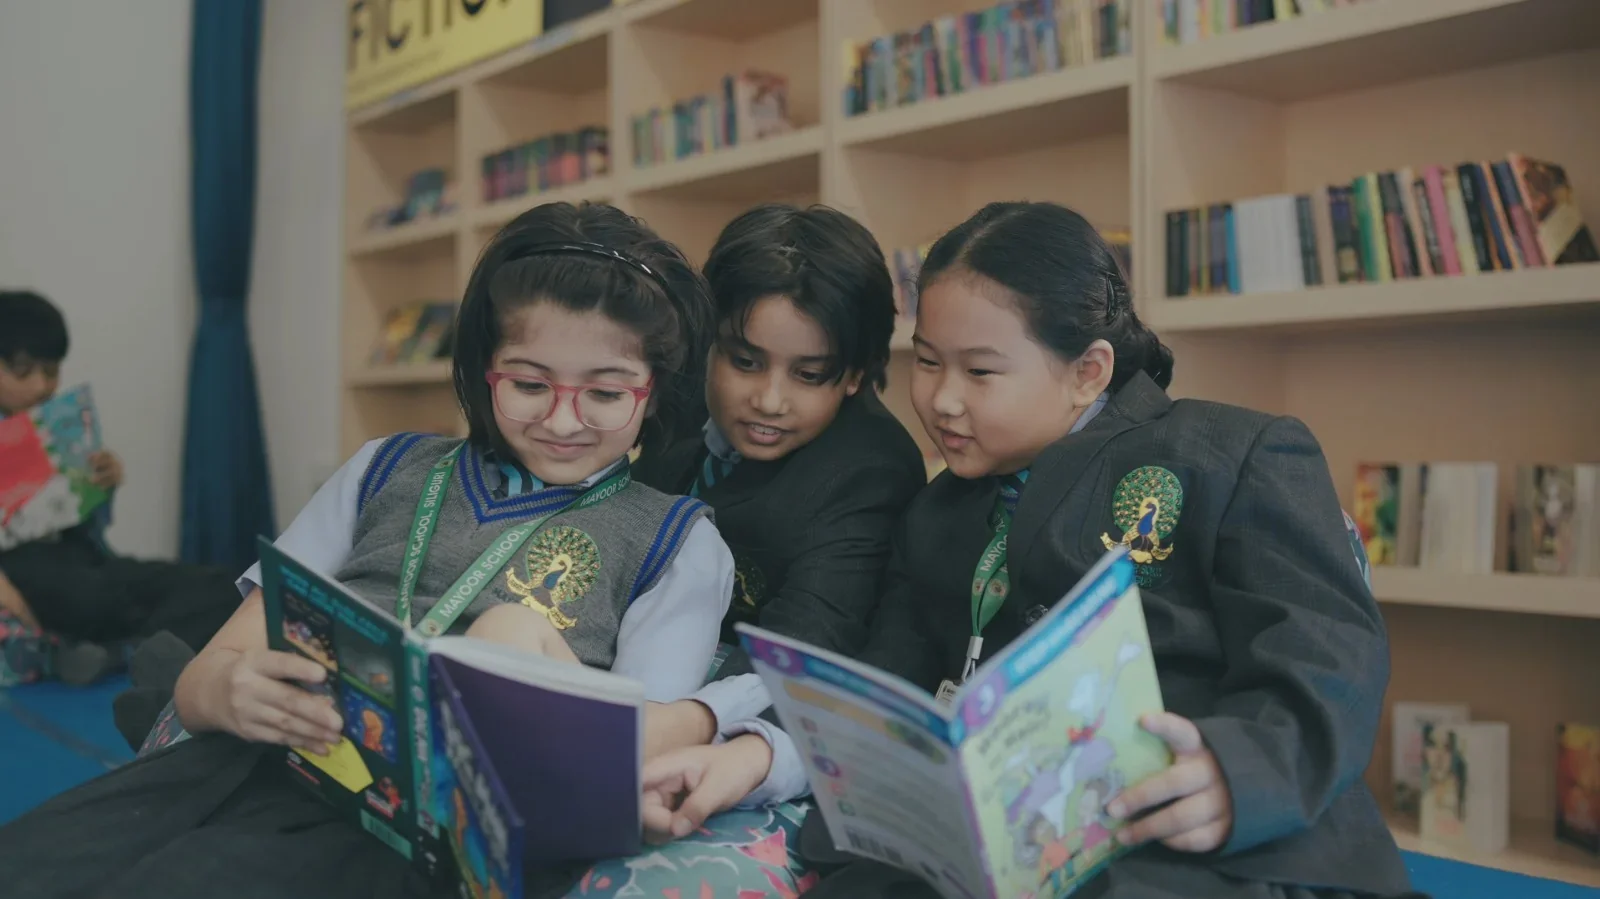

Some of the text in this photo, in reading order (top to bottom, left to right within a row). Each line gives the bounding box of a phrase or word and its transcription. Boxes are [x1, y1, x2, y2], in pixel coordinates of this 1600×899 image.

[348, 0, 508, 72] FICT
[580, 472, 631, 507] MAYOOR SCH
[401, 471, 446, 609] MAYOOR SCHOOL, SILIGURI
[440, 569, 485, 618] MAYOOR
[486, 528, 528, 569] SCHOOL,
